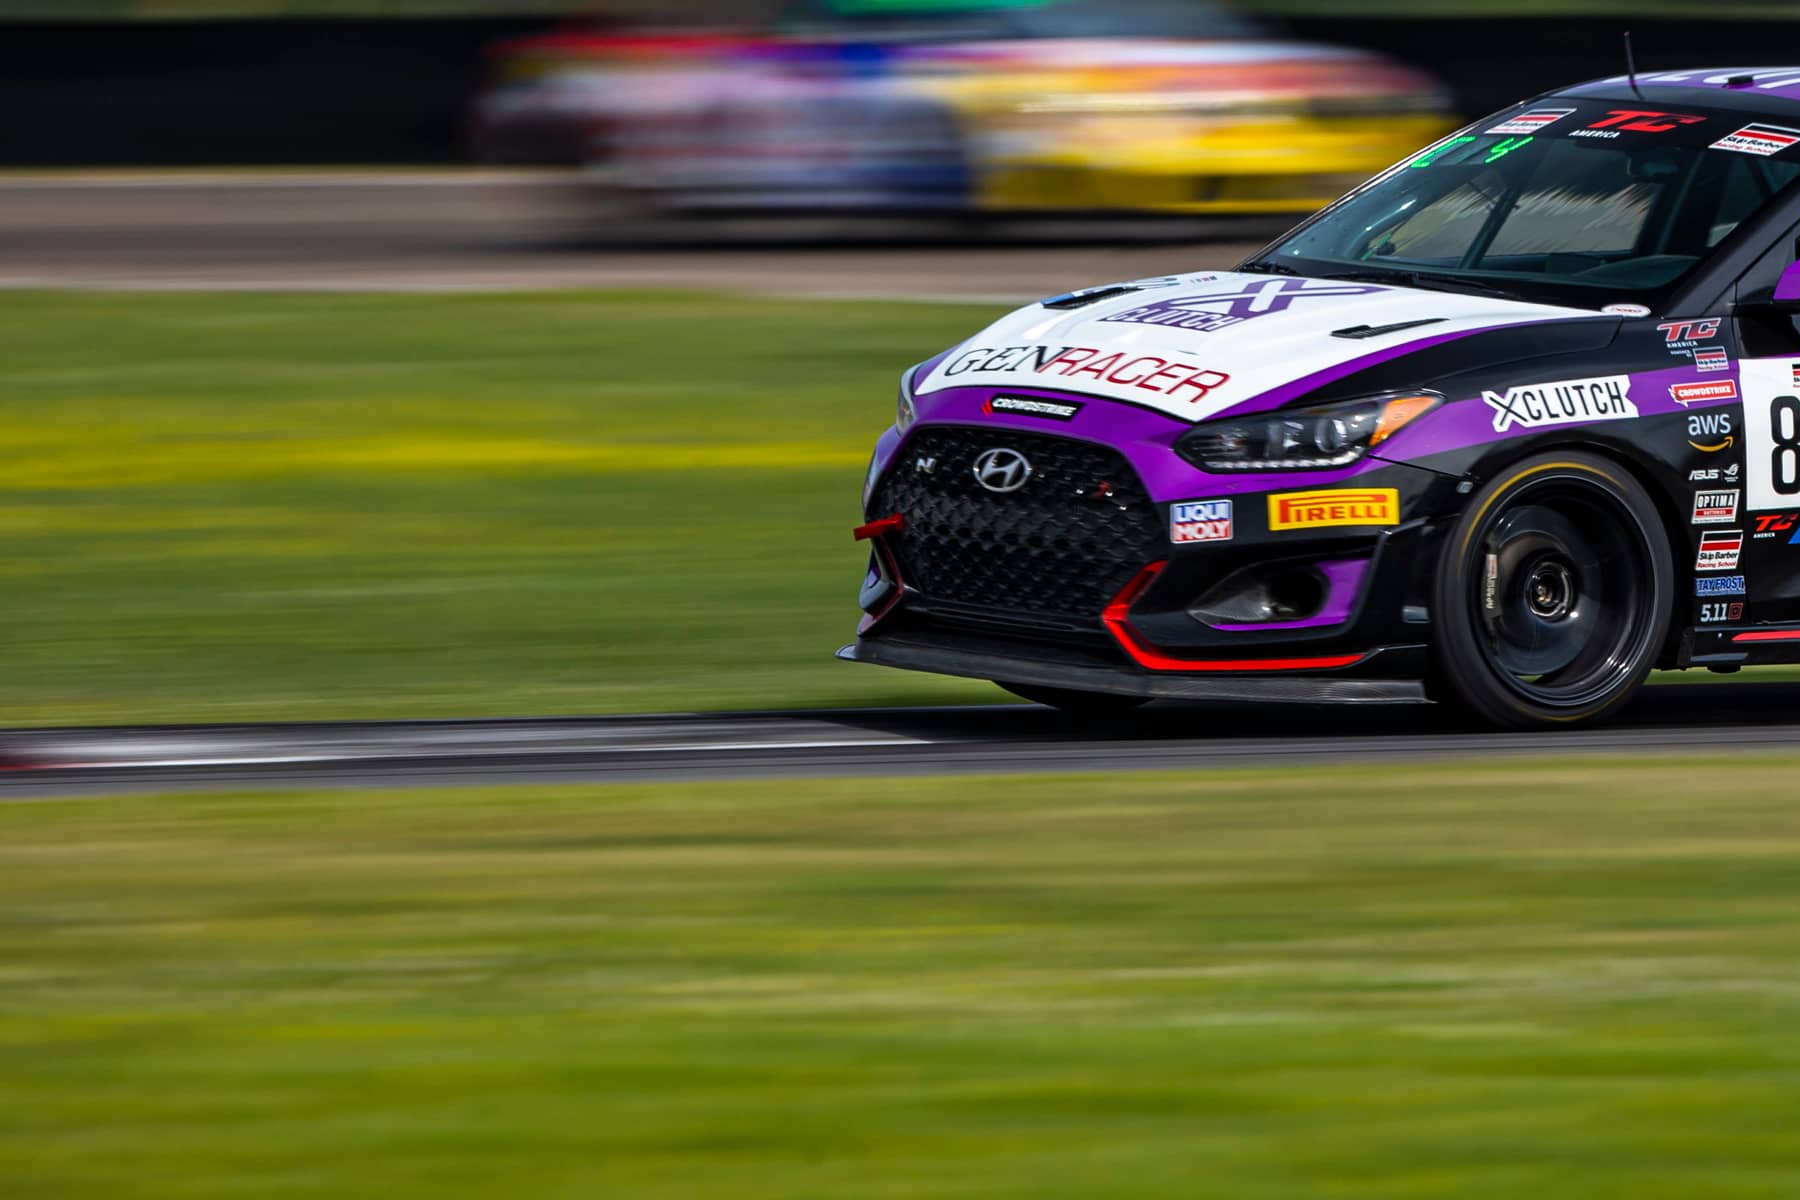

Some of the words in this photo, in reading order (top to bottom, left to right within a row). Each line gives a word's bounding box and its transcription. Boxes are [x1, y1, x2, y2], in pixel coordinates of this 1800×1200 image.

[1587, 109, 1708, 133] TC
[1568, 129, 1621, 139] AMERICA
[1748, 139, 1785, 149] Barber
[1104, 308, 1242, 332] CLUTCH
[1657, 318, 1721, 341] TC
[944, 345, 1231, 403] GENRACER
[1678, 386, 1731, 398] CROWDSTRIKE
[1489, 382, 1626, 426] XCLUTCH
[1688, 414, 1731, 436] aws
[1689, 469, 1720, 481] ASUS
[1278, 494, 1388, 523] PIRELLI
[1697, 494, 1734, 508] OPTIMA
[1176, 502, 1231, 522] LIQUI
[1175, 522, 1231, 541] MOLY
[1755, 513, 1799, 532] TC
[1699, 552, 1715, 561] Skip
[1715, 551, 1738, 560] Barber
[1696, 579, 1713, 590] TAY
[1700, 603, 1728, 622] 5.11
